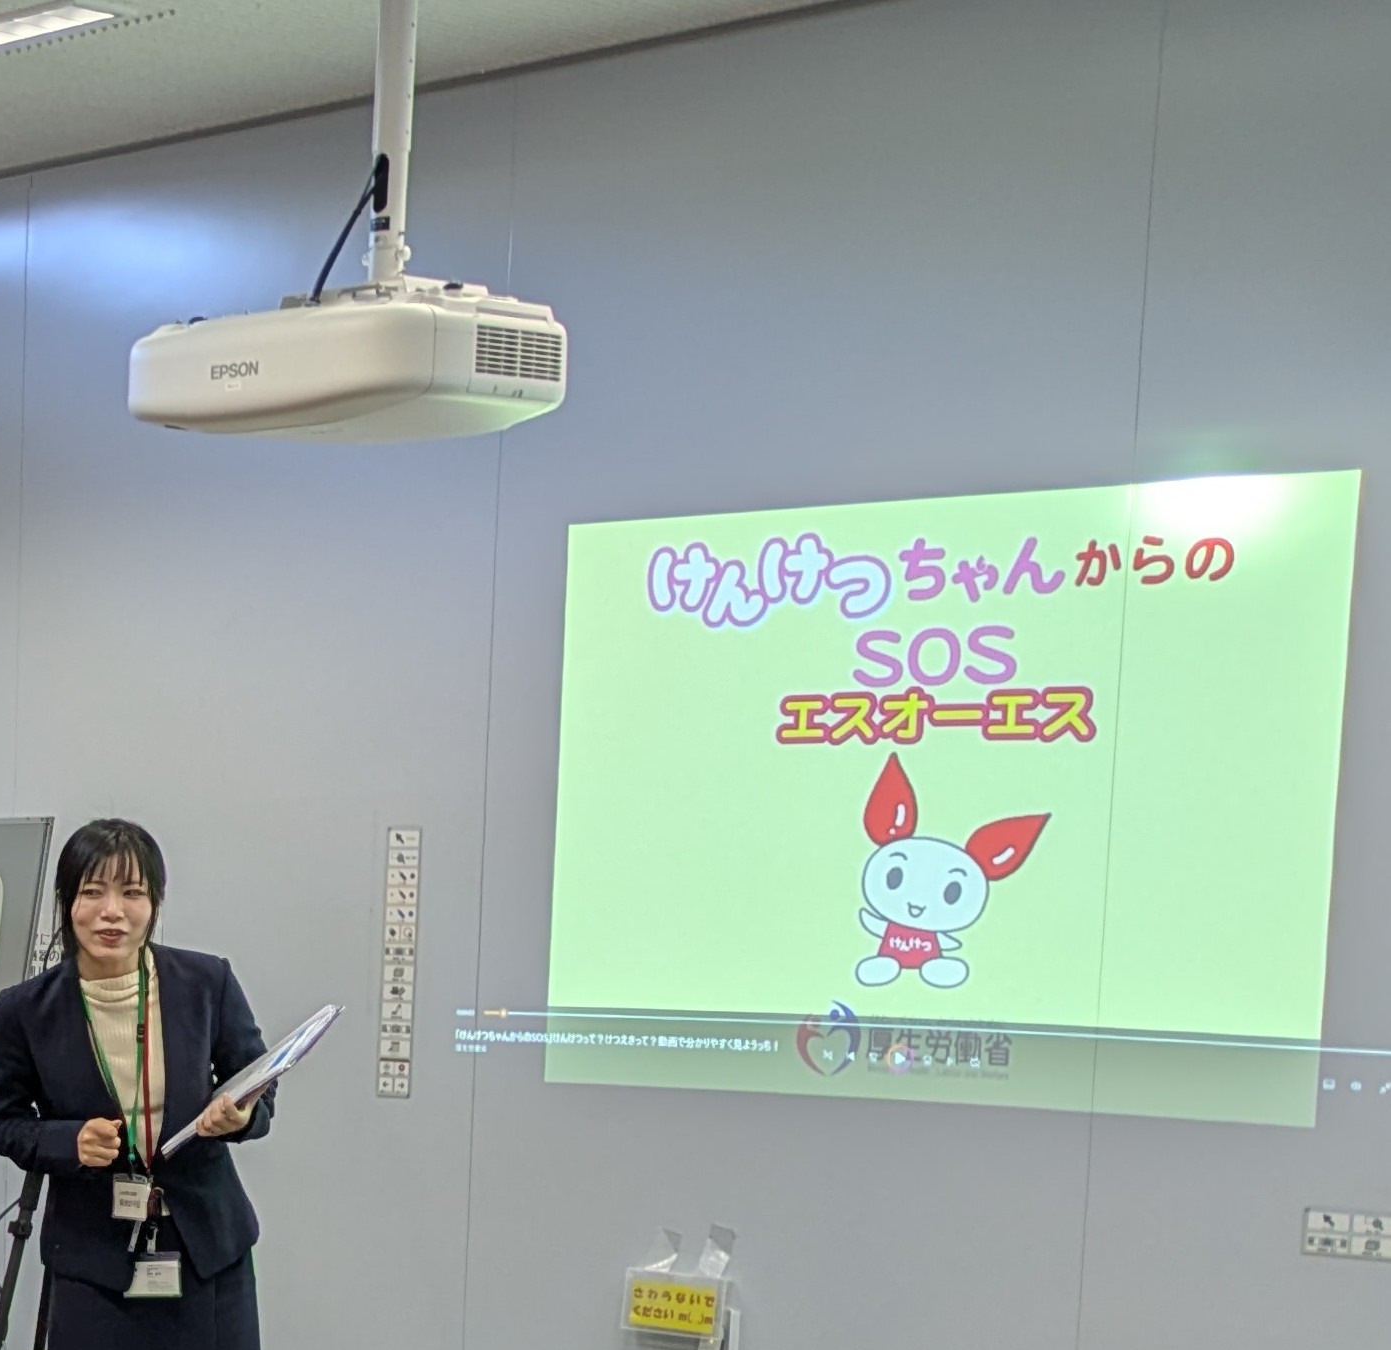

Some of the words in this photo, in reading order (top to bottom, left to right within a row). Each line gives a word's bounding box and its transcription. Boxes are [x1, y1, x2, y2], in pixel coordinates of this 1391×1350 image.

[210, 360, 259, 380] EPSON
[852, 625, 1018, 688] SOS
[776, 686, 1096, 746] エスオーエス
[633, 1287, 715, 1308] さわらないで
[632, 1305, 674, 1320] ください
